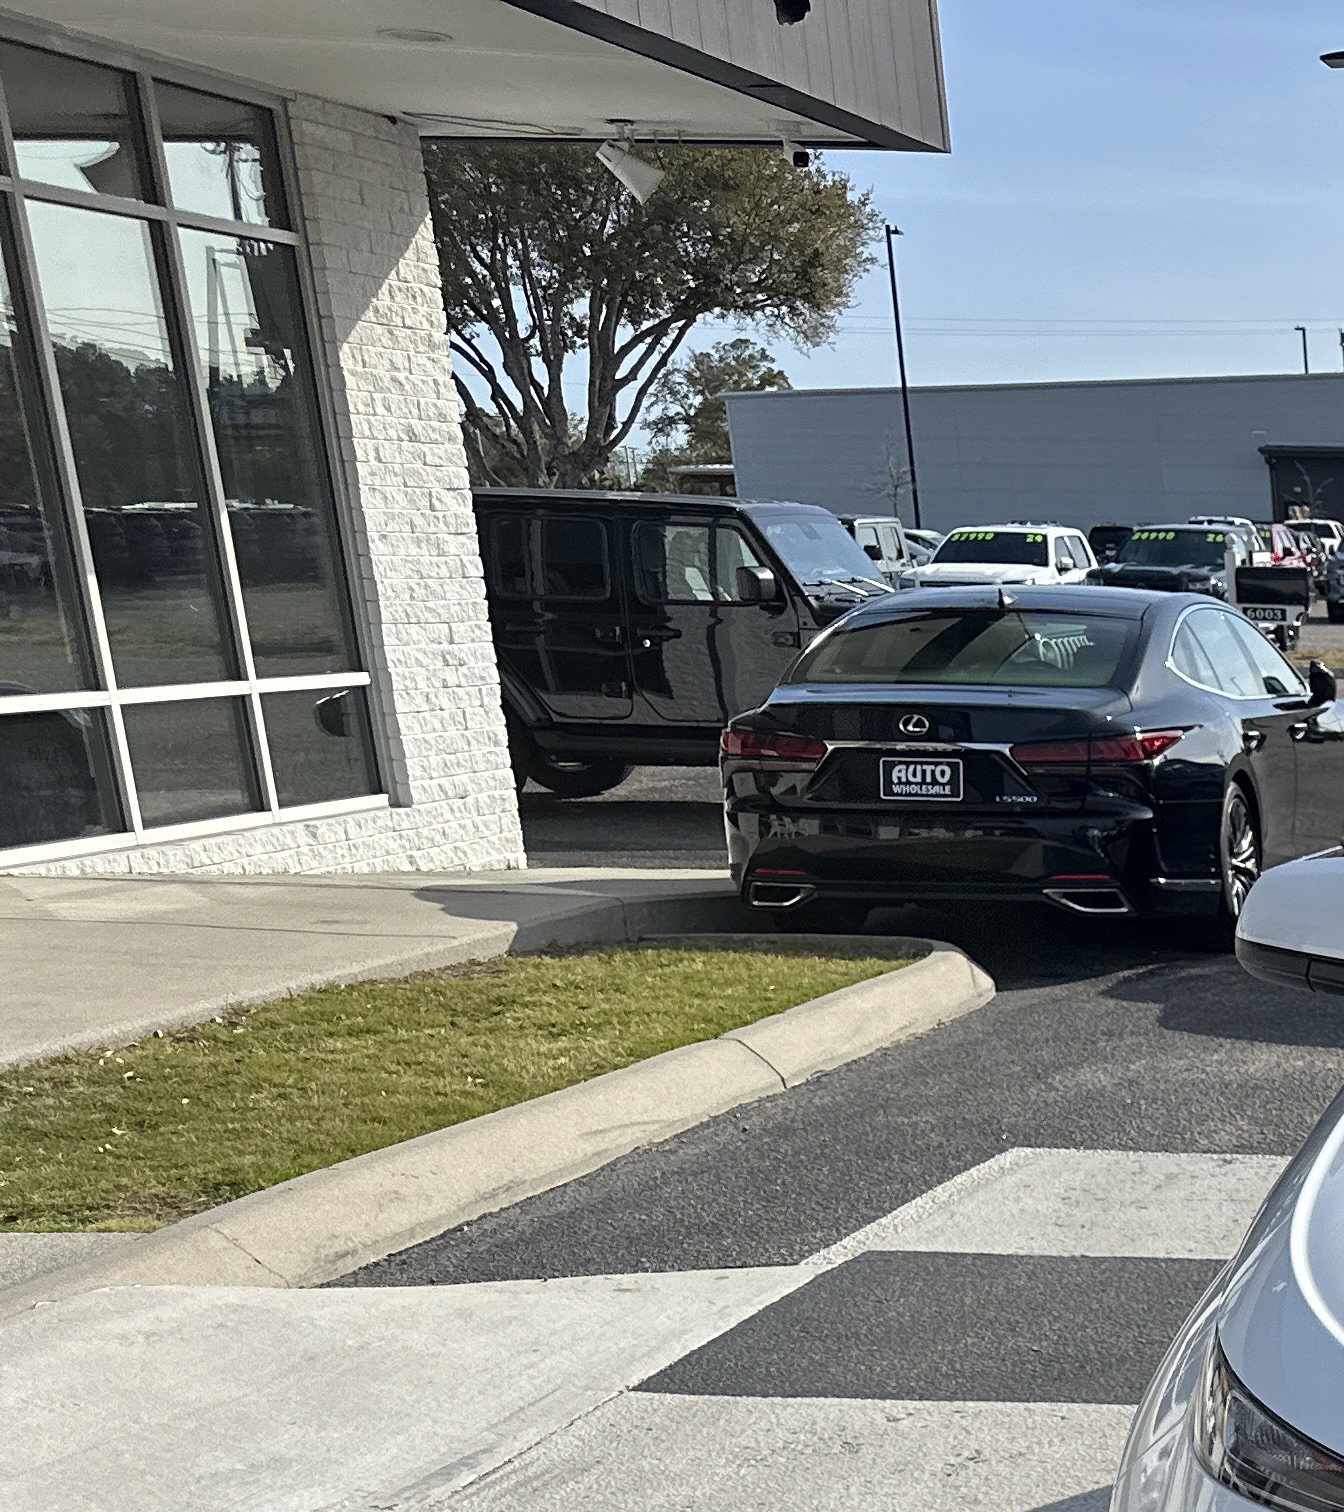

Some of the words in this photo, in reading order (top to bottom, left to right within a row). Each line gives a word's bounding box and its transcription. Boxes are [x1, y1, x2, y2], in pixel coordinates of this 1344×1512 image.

[1247, 608, 1282, 620] 6003
[891, 764, 951, 784] AUTO
[892, 784, 951, 795] WHOLESALE
